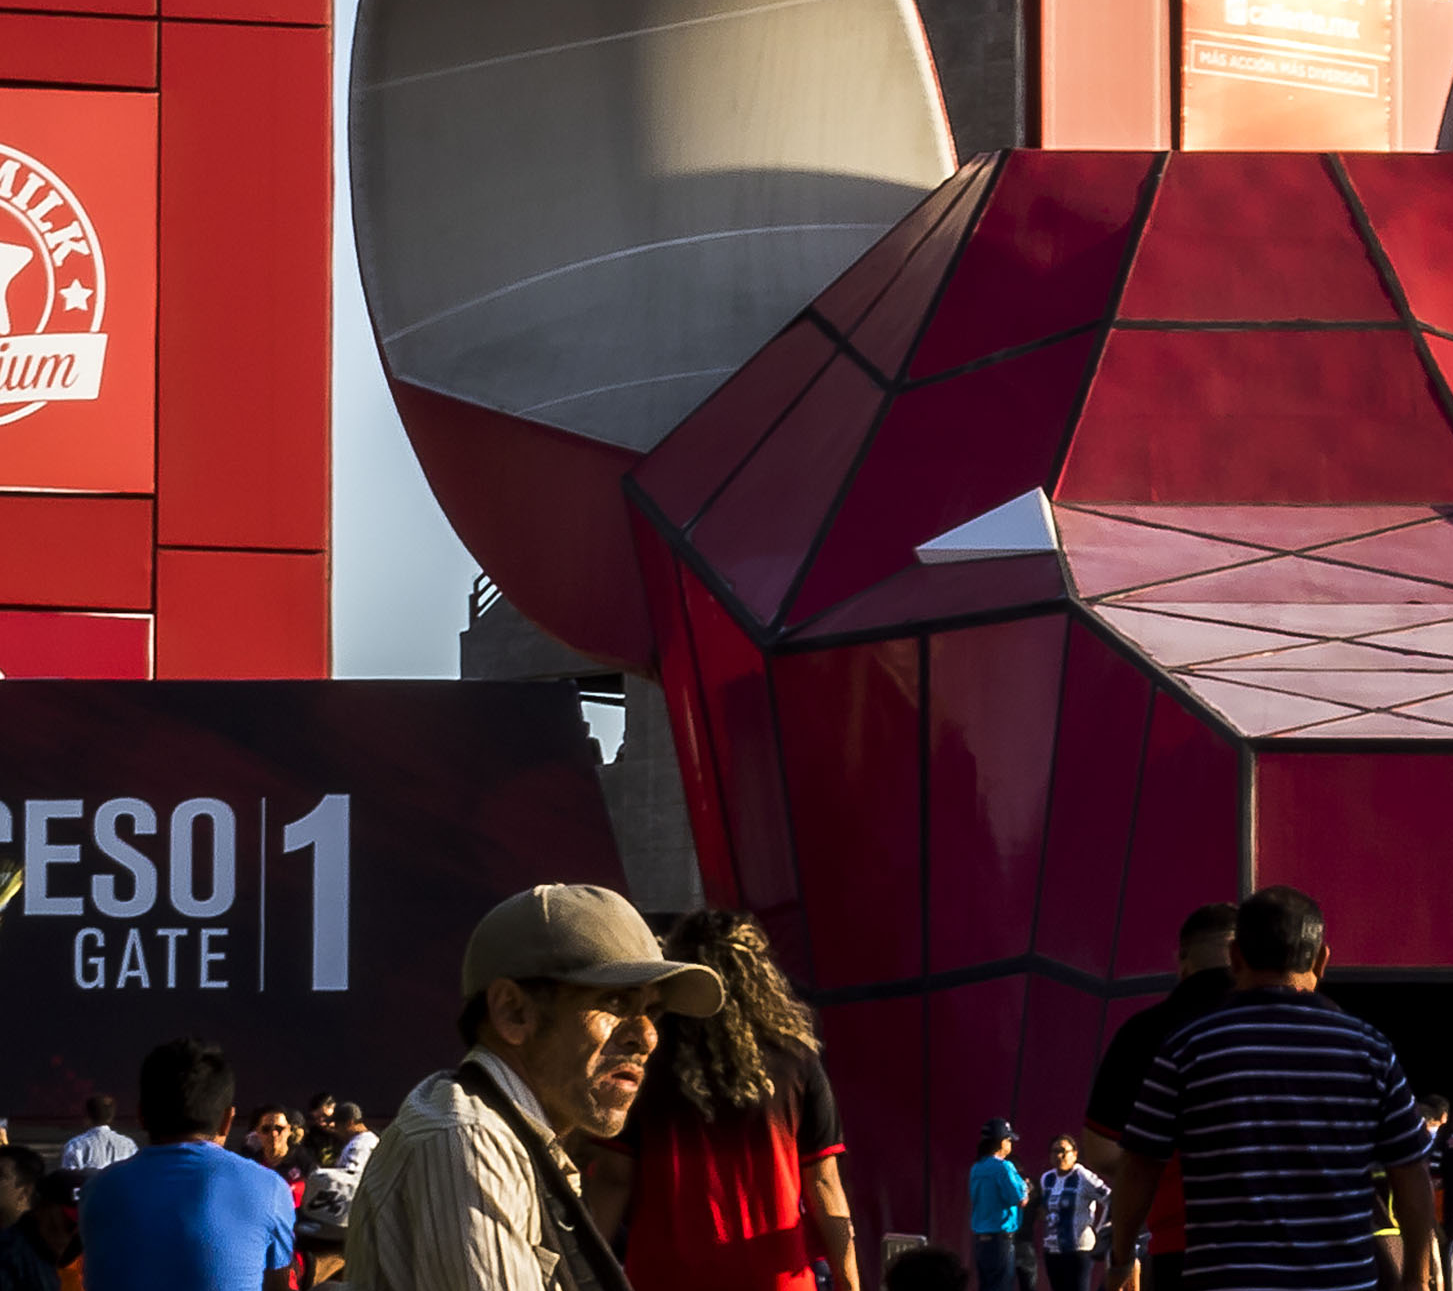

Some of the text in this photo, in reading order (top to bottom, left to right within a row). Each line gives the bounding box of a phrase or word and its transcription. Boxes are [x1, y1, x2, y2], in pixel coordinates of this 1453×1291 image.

[0, 342, 80, 392] ium
[0, 797, 236, 918] ESO
[283, 794, 350, 991] 1
[74, 927, 229, 990] GATE
